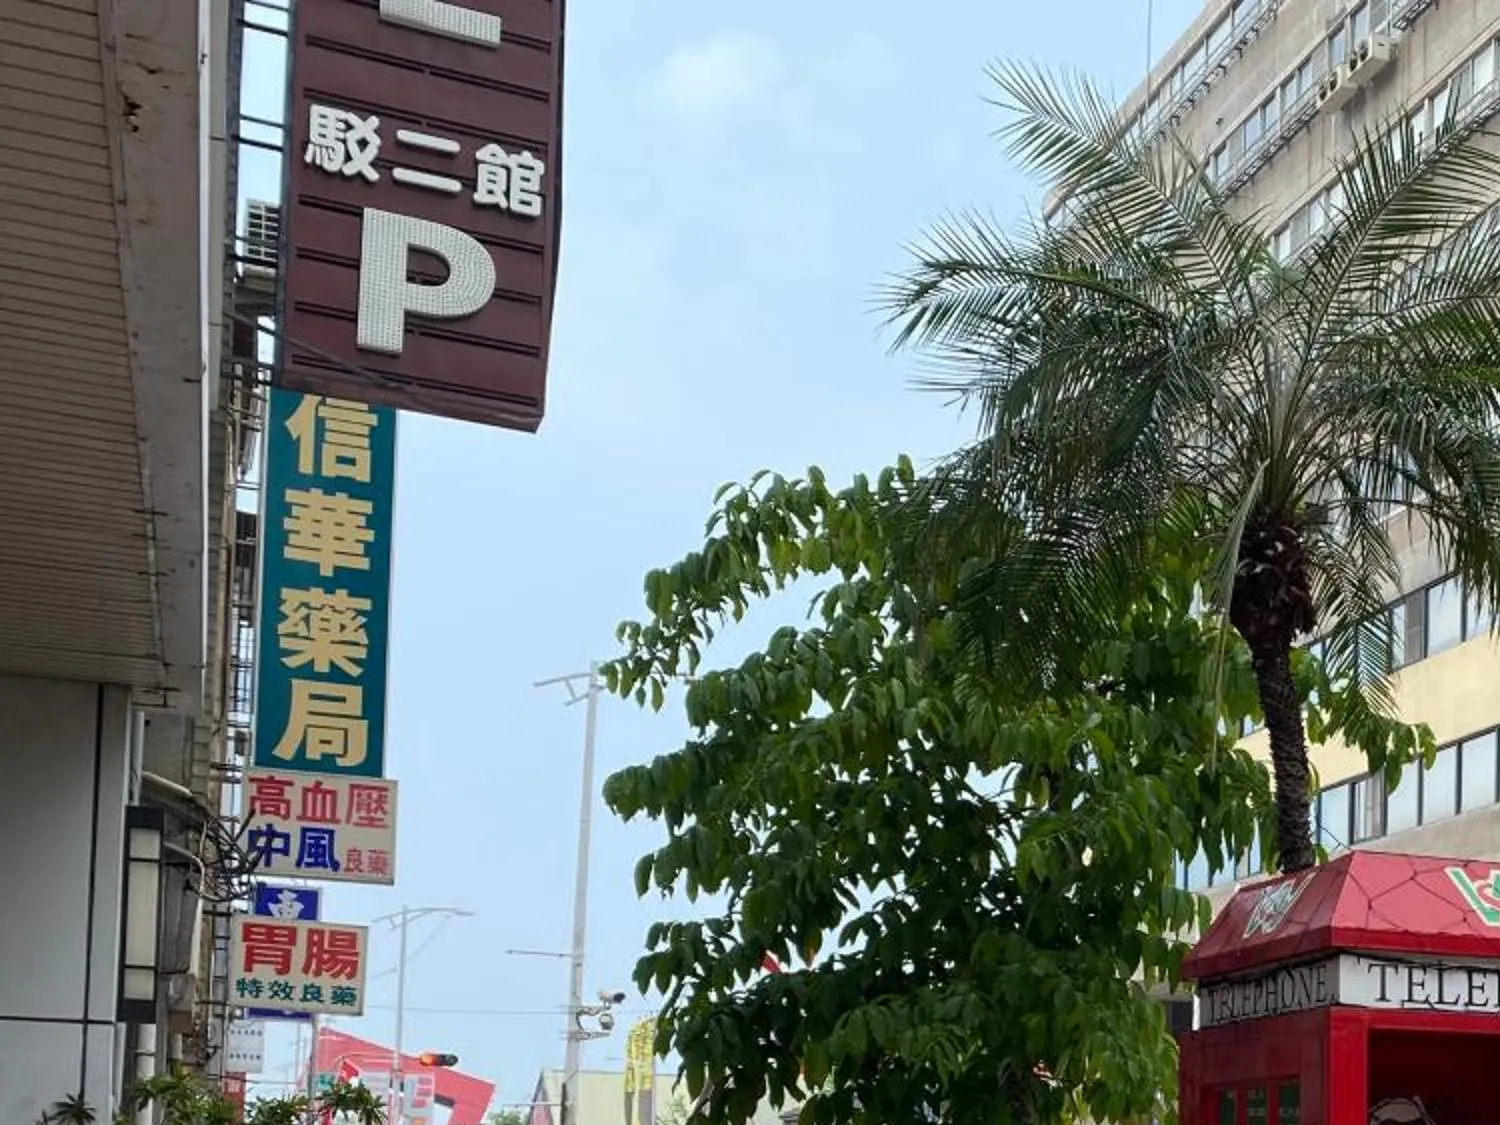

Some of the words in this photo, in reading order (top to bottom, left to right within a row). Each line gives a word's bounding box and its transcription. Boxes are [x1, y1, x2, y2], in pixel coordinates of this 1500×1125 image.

[303, 103, 546, 217] 駁二館
[356, 207, 497, 355] P
[272, 393, 378, 767] 信華藥局
[247, 775, 389, 829] 高血壓
[247, 823, 341, 872] 中風
[343, 848, 389, 876] 良藥
[242, 922, 361, 980] 胃腸
[236, 977, 358, 1006] 特效良藥
[1207, 963, 1328, 1023] TELEPHONE
